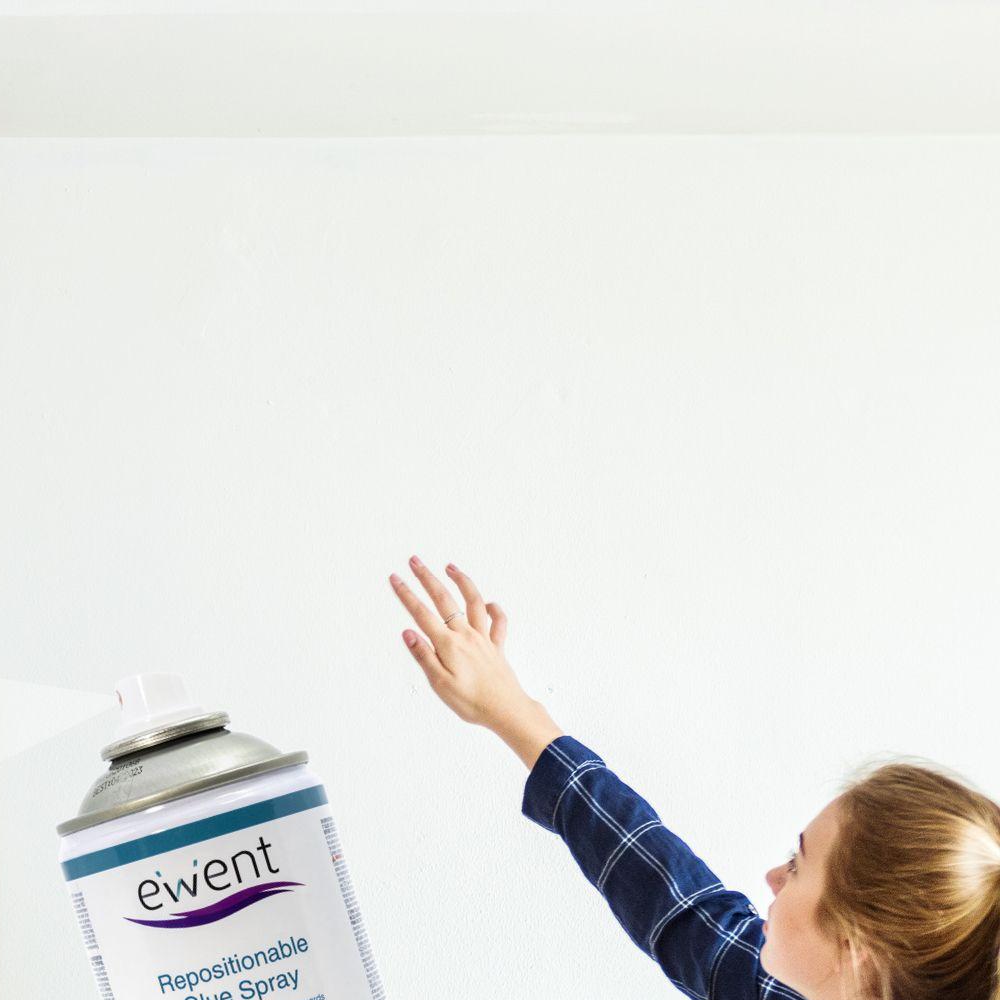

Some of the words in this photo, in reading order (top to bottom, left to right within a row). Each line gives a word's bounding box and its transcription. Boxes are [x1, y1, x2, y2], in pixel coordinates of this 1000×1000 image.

[138, 836, 280, 911] ewent
[157, 936, 309, 994] Repositionable
[238, 969, 300, 1000] Spray
